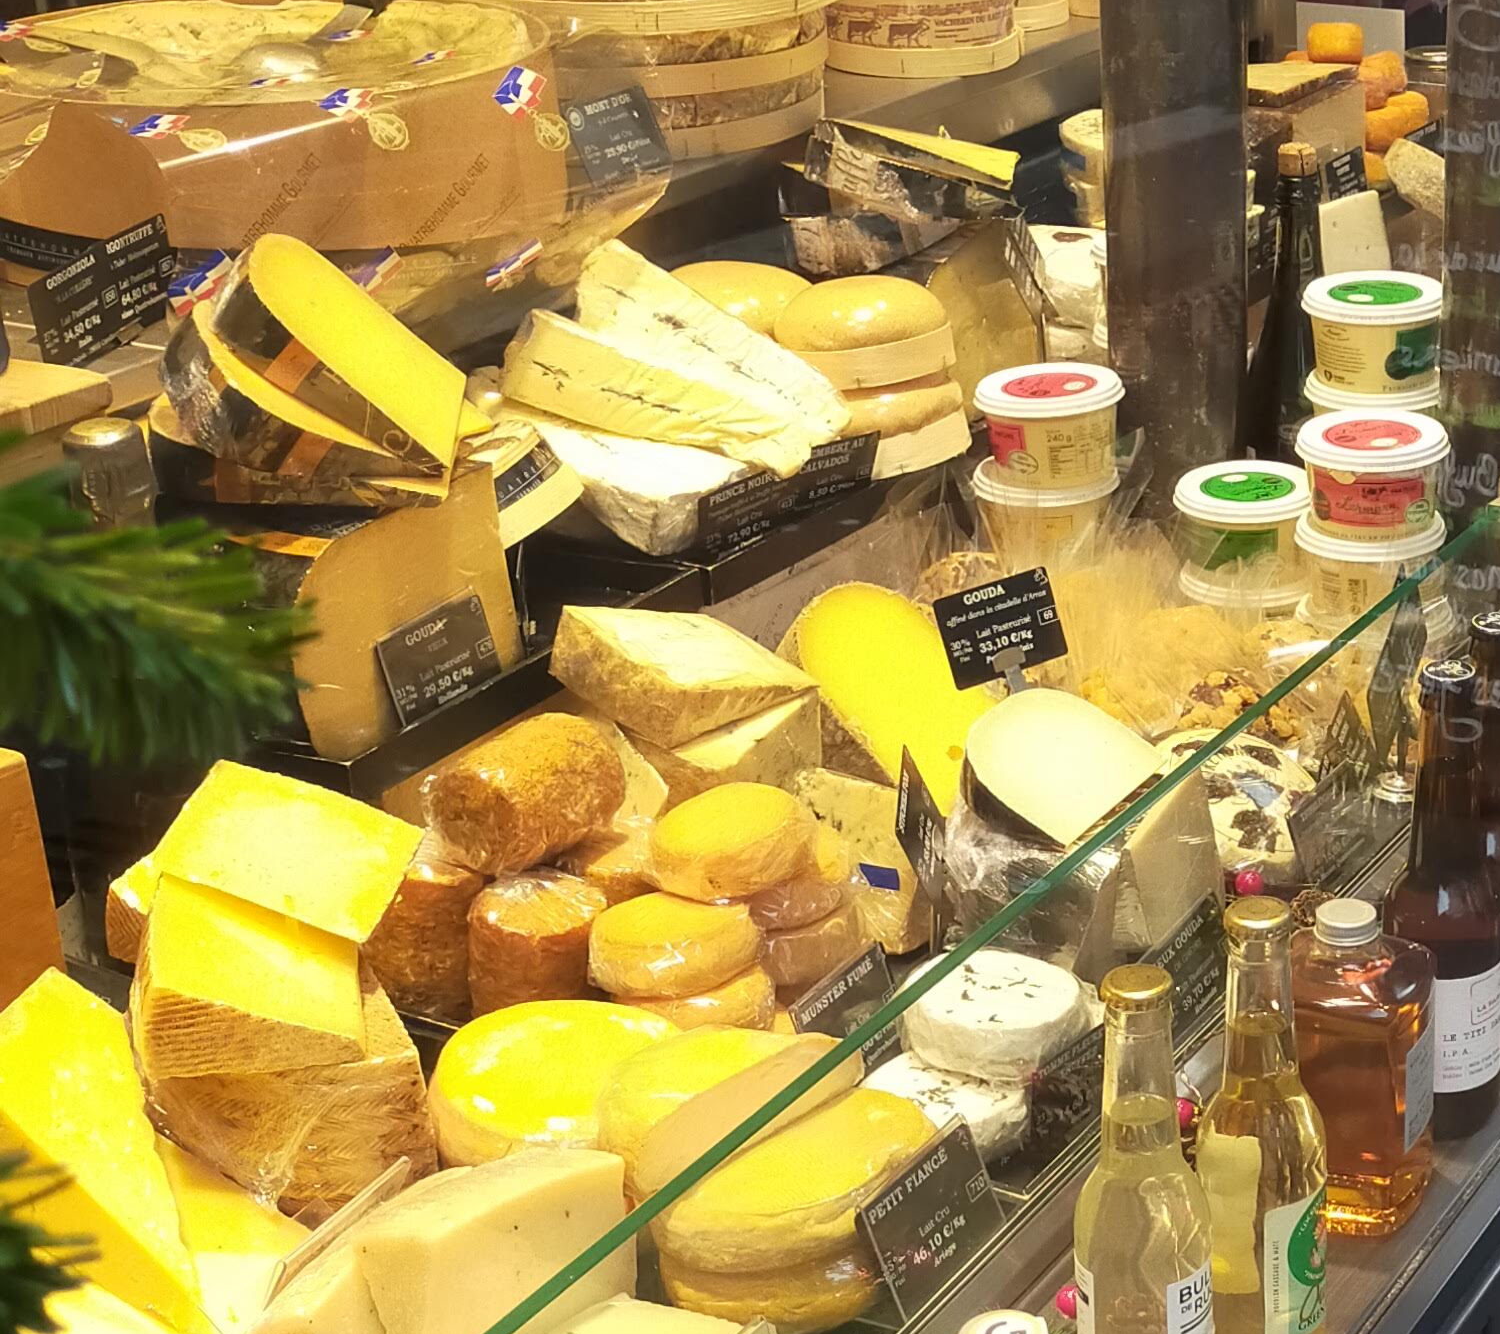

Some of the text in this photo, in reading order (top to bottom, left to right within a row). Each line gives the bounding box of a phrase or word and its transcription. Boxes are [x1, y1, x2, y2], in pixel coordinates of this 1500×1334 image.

[583, 98, 610, 116] MONT
[46, 252, 96, 290] GORGONZOLA
[799, 453, 850, 475] CALVADOS
[709, 481, 746, 507] PRINCE
[963, 584, 1006, 606] GOUDA
[1042, 609, 1054, 620] 69
[405, 618, 448, 647] GOUDA
[975, 626, 992, 639] Lait
[979, 635, 1010, 654] 33,10
[423, 674, 451, 700] 29,50
[1174, 913, 1205, 950] GOUDA
[800, 953, 875, 1027] MUNSTER FUMÉ
[1442, 1022, 1488, 1043] LE TITI
[867, 1145, 949, 1226] PETIT FIANCÉ
[968, 1175, 986, 1196] 710
[918, 1204, 950, 1238] Lait Cru
[912, 1231, 944, 1266] 46,10
[1181, 1302, 1193, 1315] DE
